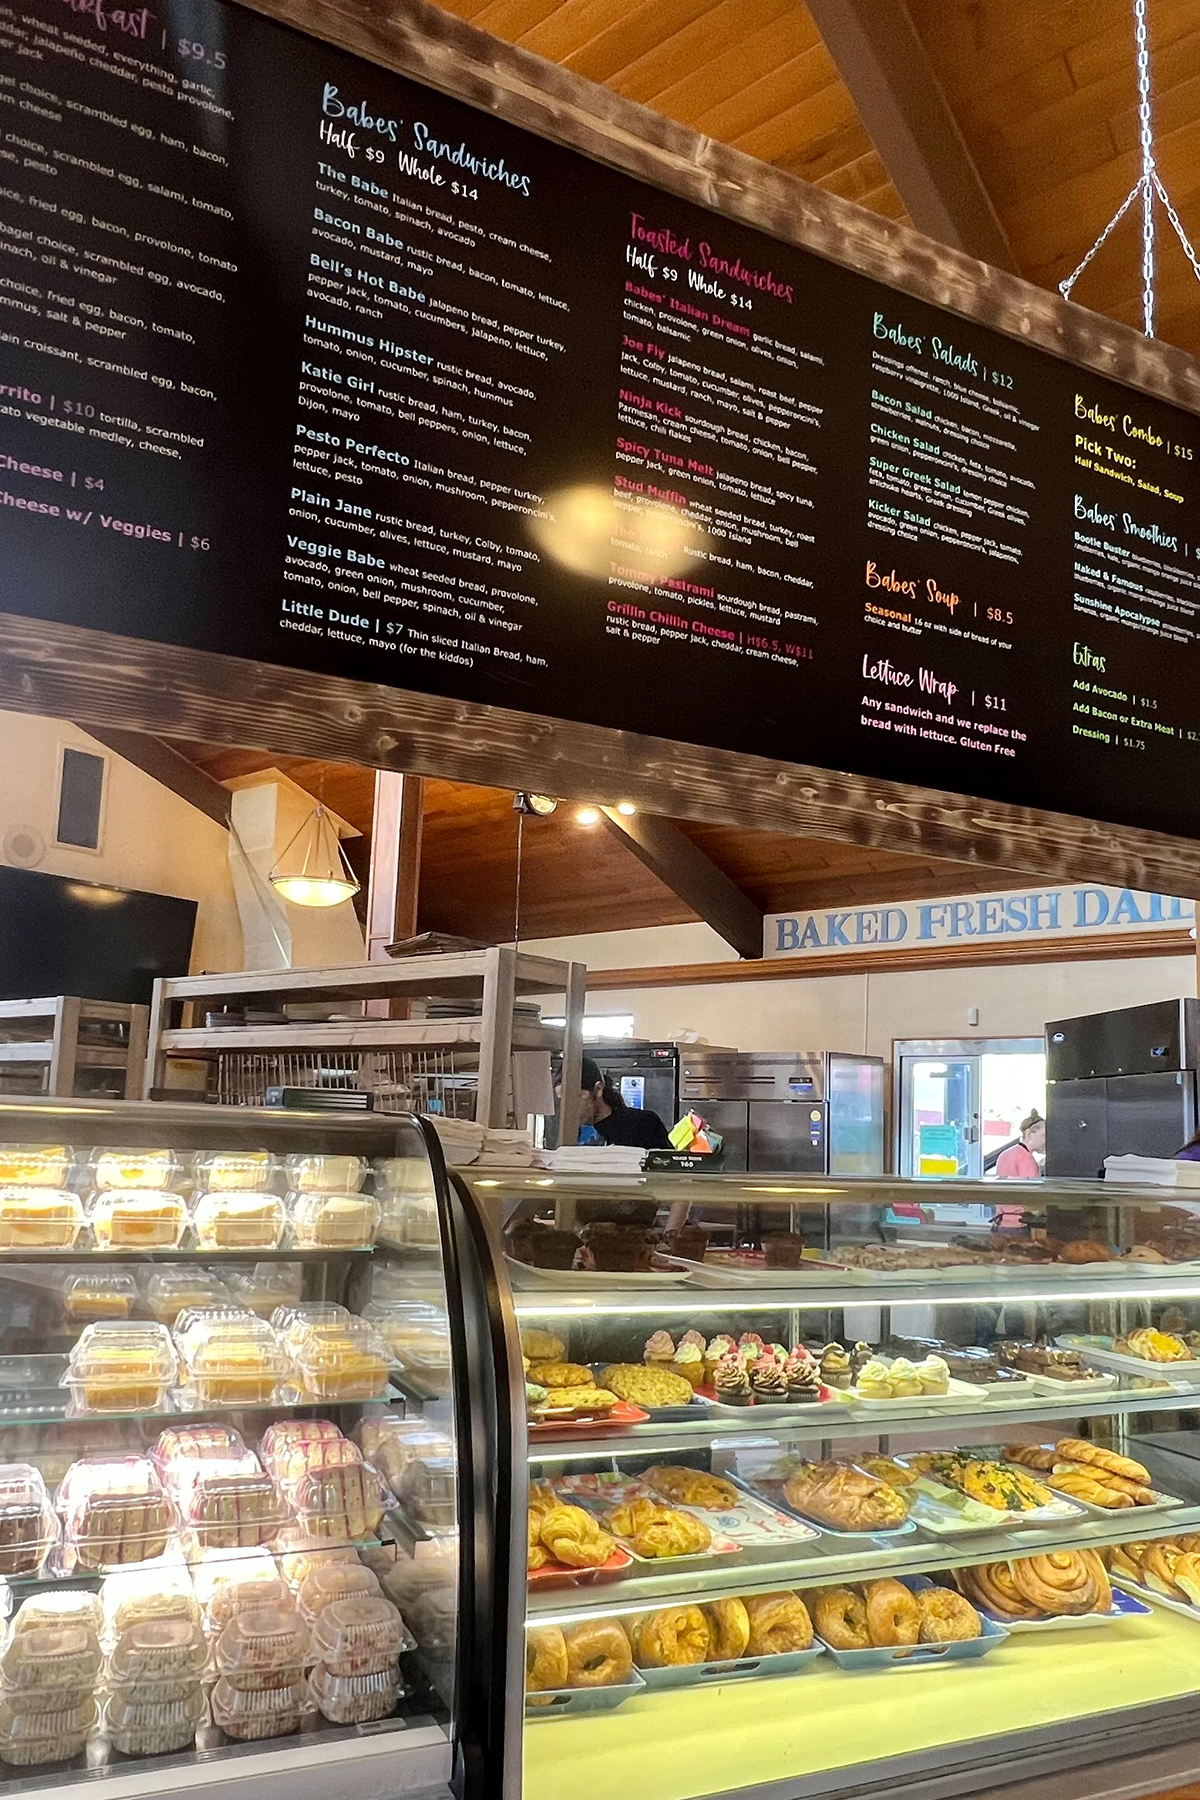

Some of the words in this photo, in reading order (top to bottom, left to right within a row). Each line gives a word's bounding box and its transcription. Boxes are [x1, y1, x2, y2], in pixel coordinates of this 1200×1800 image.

[177, 37, 227, 69] $9.5
[319, 120, 360, 158] Half
[366, 147, 385, 164] $9
[398, 150, 445, 187] Whole
[451, 182, 478, 201] $14
[414, 122, 531, 197] Sandwiches
[317, 162, 345, 181] The
[351, 175, 388, 198] Babe
[314, 208, 360, 233] Bacon
[366, 227, 403, 249] Babe
[630, 212, 693, 261] Toasted
[698, 242, 794, 304] Sandwiches
[310, 253, 352, 276] Bell's
[357, 270, 383, 288] Hot
[389, 281, 425, 302] Babe
[626, 245, 658, 278] Half
[662, 266, 678, 281] $9
[688, 269, 726, 299] Whole
[731, 293, 753, 310] $14
[670, 298, 708, 320] Italian
[712, 314, 750, 336] Dream
[305, 315, 373, 346] Hummus
[379, 339, 433, 364] Hipster
[622, 336, 643, 350] Joe
[647, 343, 665, 359] Fly
[24, 340, 82, 362] croissant,
[87, 358, 147, 379] scrambled
[151, 375, 175, 389] egg,
[180, 381, 216, 400] bacon,
[302, 361, 341, 383] Katie
[347, 376, 374, 393] Girl
[932, 336, 979, 377] Salads
[992, 371, 1014, 390] $12
[619, 389, 651, 408] Ninja
[656, 402, 681, 417] Kick
[872, 390, 901, 407] Bacon
[905, 402, 932, 419] Salad
[25, 412, 85, 433] vegetable
[89, 428, 134, 447] medley,
[139, 441, 181, 459] cheese,
[64, 400, 94, 417] $10
[100, 412, 141, 431] tortilla,
[146, 426, 203, 446] scrambled
[870, 423, 910, 443] Chicken
[913, 438, 939, 454] Salad
[1123, 415, 1163, 447] Combo
[1174, 445, 1193, 461] $15
[296, 424, 339, 445] Pesto
[346, 438, 409, 465] Perfecto
[617, 438, 649, 458] Spicy
[654, 449, 683, 466] Tuna
[688, 459, 713, 475] Melt
[1075, 434, 1102, 457] Pick
[1105, 446, 1136, 470] Two:
[0, 454, 62, 481] Cheese
[85, 477, 104, 490] $4
[614, 476, 643, 492] Stud
[646, 485, 686, 504] Muffin
[869, 456, 899, 473] Super
[902, 467, 931, 484] Greek
[934, 478, 960, 493] Salad
[1075, 455, 1092, 468] Half
[1093, 463, 1136, 486] Sandwich,
[1137, 479, 1162, 497] Salad,
[1164, 489, 1185, 504] Soup
[291, 487, 329, 507] Plain
[335, 499, 371, 518] Jane
[868, 499, 900, 516] Kicker
[903, 510, 930, 526] Salad
[66, 509, 92, 524] w/
[100, 515, 171, 541] Veggies
[190, 536, 209, 550] $6
[1123, 513, 1178, 552] Smoothies
[287, 535, 341, 557] Veggie
[347, 549, 385, 568] Babe
[1103, 543, 1130, 558] Buster
[610, 562, 657, 586] Tommy
[660, 576, 714, 598] Pastrami
[1074, 562, 1101, 578] Naked
[1111, 574, 1144, 592] Famous
[865, 602, 912, 623] Seasonal
[926, 578, 962, 615] Soup
[987, 607, 1014, 624] $8.5
[1073, 593, 1112, 612] Sunshine
[1114, 605, 1161, 628] Apocalypse
[282, 599, 323, 618] Little
[329, 609, 369, 628] Dude
[387, 622, 403, 634] $7
[407, 628, 428, 640] Thin
[431, 635, 458, 647] sliced
[461, 640, 490, 653] Italian
[493, 647, 522, 661] Bread,
[526, 654, 547, 666] ham,
[607, 601, 645, 618] Grillin
[649, 611, 688, 628] Chillin
[692, 621, 734, 640] Cheese
[279, 619, 323, 635] cheddar,
[327, 628, 364, 644] lettuce,
[369, 638, 396, 650] mayo
[399, 643, 417, 653] (for
[420, 648, 436, 658] the
[439, 651, 473, 667] kiddos)
[606, 615, 629, 630] rustic
[631, 620, 657, 634] bread,
[660, 628, 688, 639] pepper
[690, 634, 708, 646] jack,
[711, 639, 743, 653] cheddar,
[745, 648, 769, 658] cream
[771, 654, 798, 666] cheese,
[1073, 642, 1106, 673] Extras
[862, 654, 914, 687] Lettuce
[919, 667, 959, 705] Wrap
[985, 695, 1006, 711] $11
[1073, 680, 1090, 692] Add
[1092, 684, 1128, 702] Avocado
[1141, 698, 1158, 709] $1.5
[861, 696, 881, 710] Any
[885, 702, 932, 719] sandwich
[935, 714, 954, 724] and
[957, 718, 971, 728] we
[974, 723, 1009, 736] replace
[1011, 729, 1026, 740] the
[861, 715, 891, 729] bread
[894, 724, 916, 735] with
[960, 736, 991, 751] Gluten
[994, 744, 1015, 756] Free
[1073, 702, 1090, 714] Add
[1092, 707, 1118, 721] Bacon
[1119, 716, 1128, 724] or
[1131, 717, 1152, 730] Extra
[1155, 722, 1175, 736] Meat
[1073, 725, 1110, 743] Dressing
[1123, 738, 1146, 750] $1.75
[776, 908, 908, 951] BAKED
[915, 892, 1062, 939] FRESH
